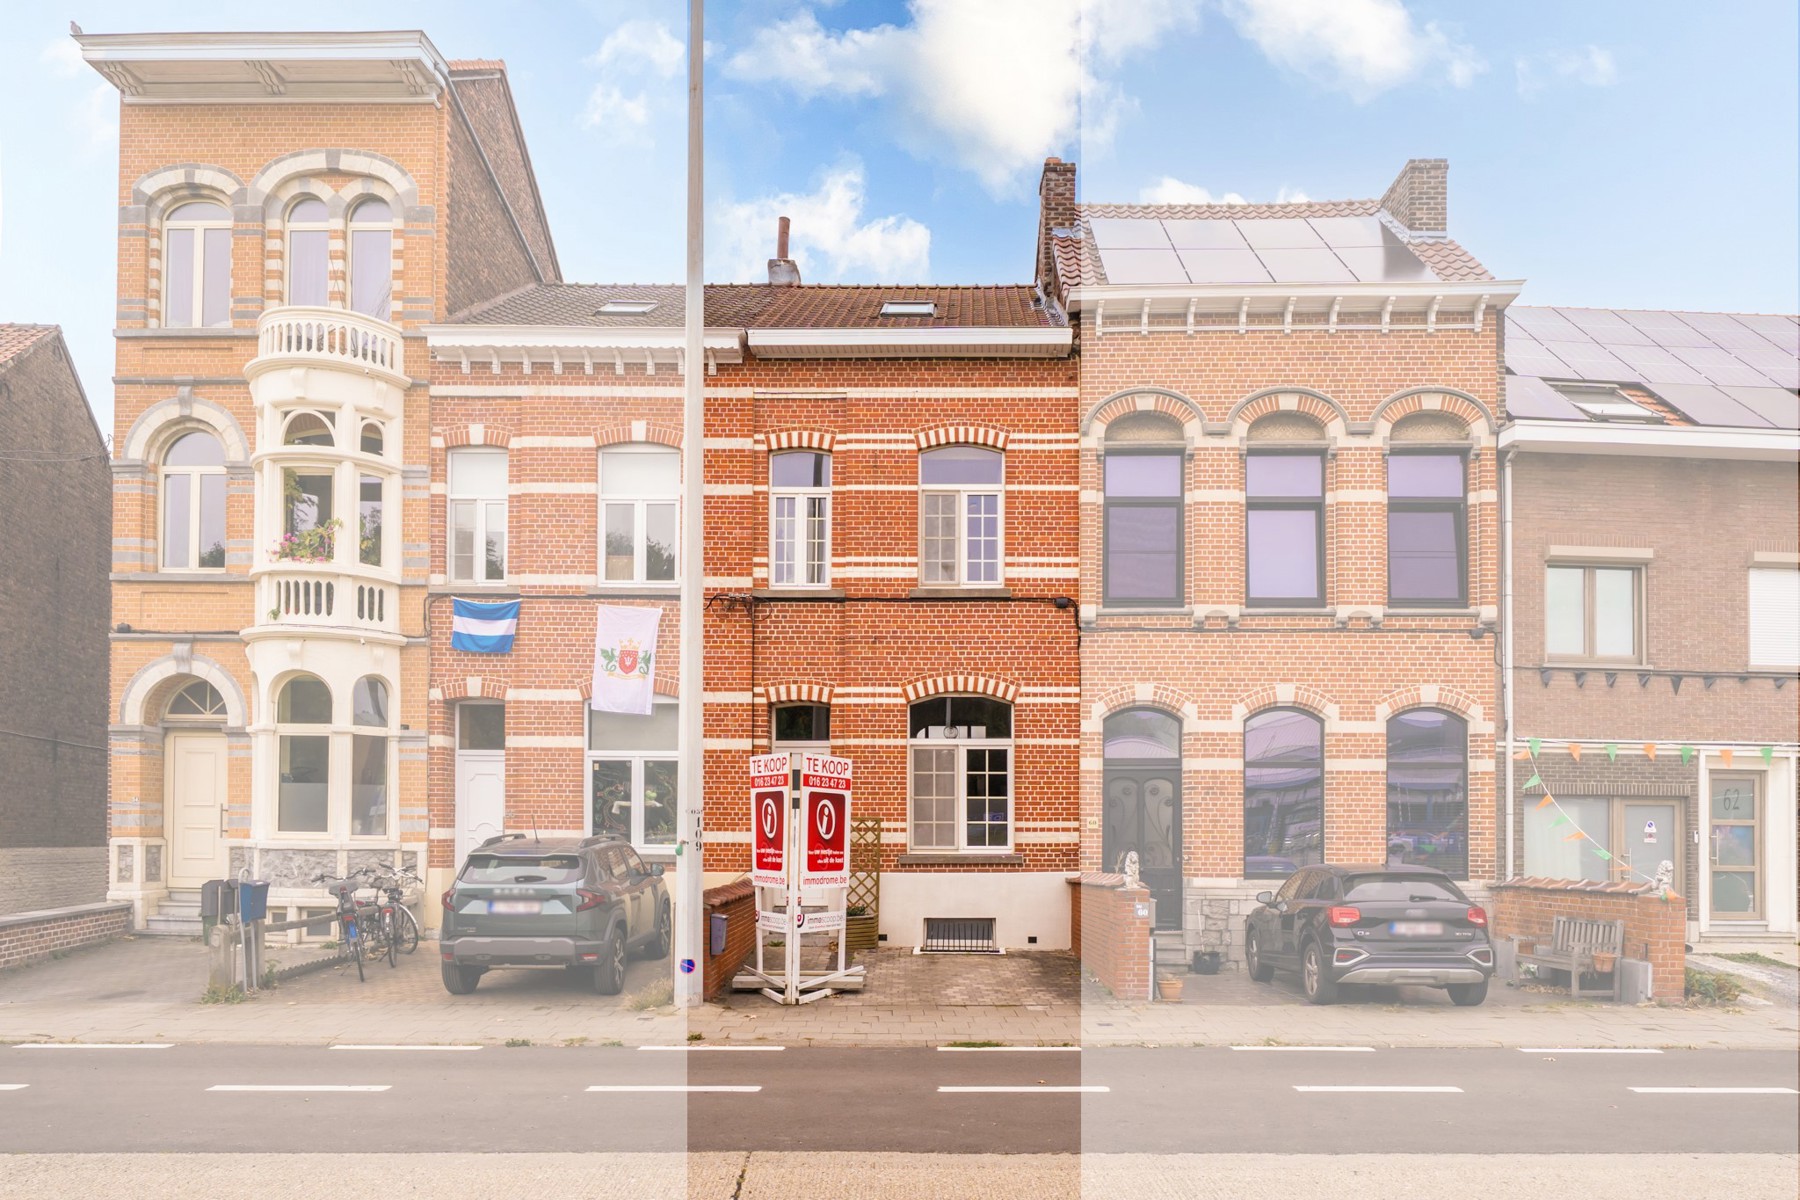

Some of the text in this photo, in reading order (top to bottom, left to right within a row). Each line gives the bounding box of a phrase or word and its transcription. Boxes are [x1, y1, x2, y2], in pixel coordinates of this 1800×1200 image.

[752, 757, 787, 774] TE KOOP
[806, 757, 849, 775] TE KOOP
[755, 775, 785, 787] 016 23 47 23
[808, 776, 846, 789] 016 23 47 23
[1723, 788, 1740, 811] 62
[754, 875, 785, 885] immodrome.be
[803, 875, 847, 885] immodrome.be
